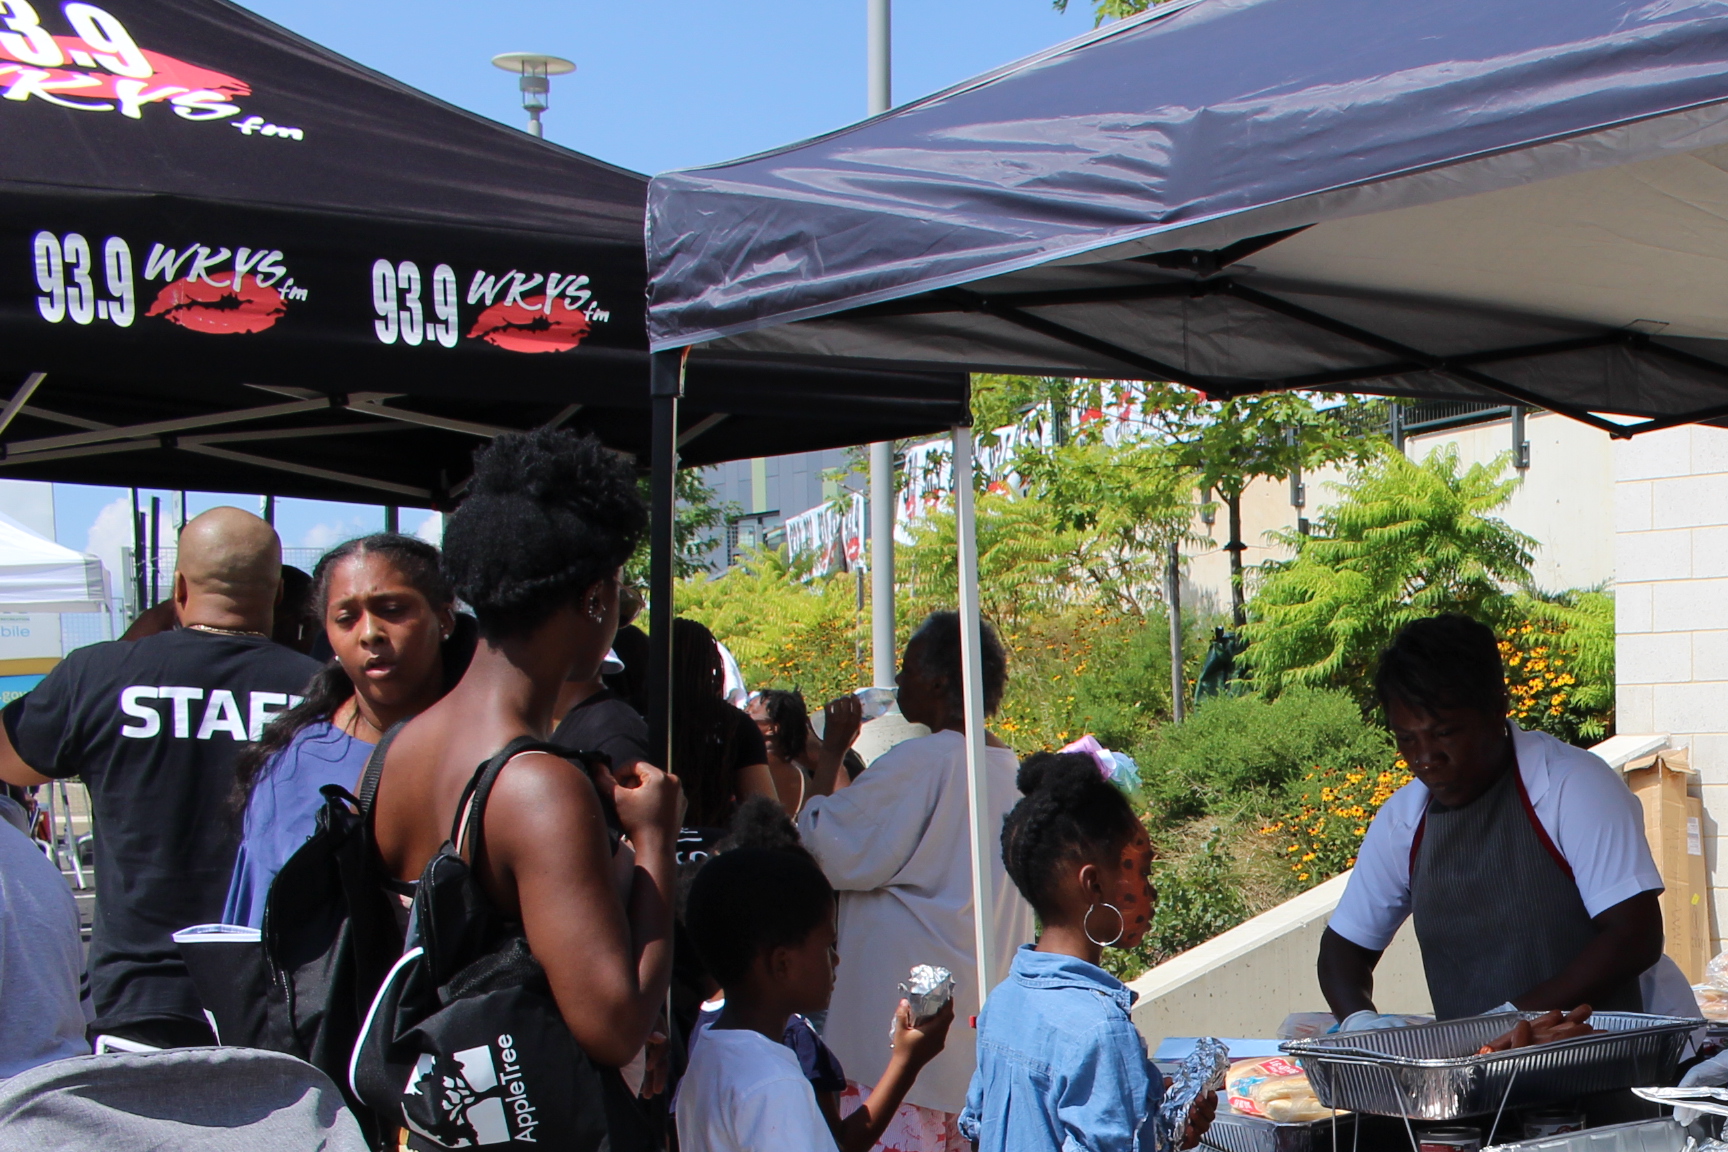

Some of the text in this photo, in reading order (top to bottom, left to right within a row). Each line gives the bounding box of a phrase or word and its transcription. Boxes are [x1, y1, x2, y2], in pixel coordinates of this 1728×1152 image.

[0, 62, 303, 141] KYS fm
[34, 231, 308, 327] 93.9 WKYS fm
[372, 258, 609, 348] 93.9 WKYS fm
[120, 685, 304, 741] STAF
[498, 1034, 538, 1142] AppleTree
